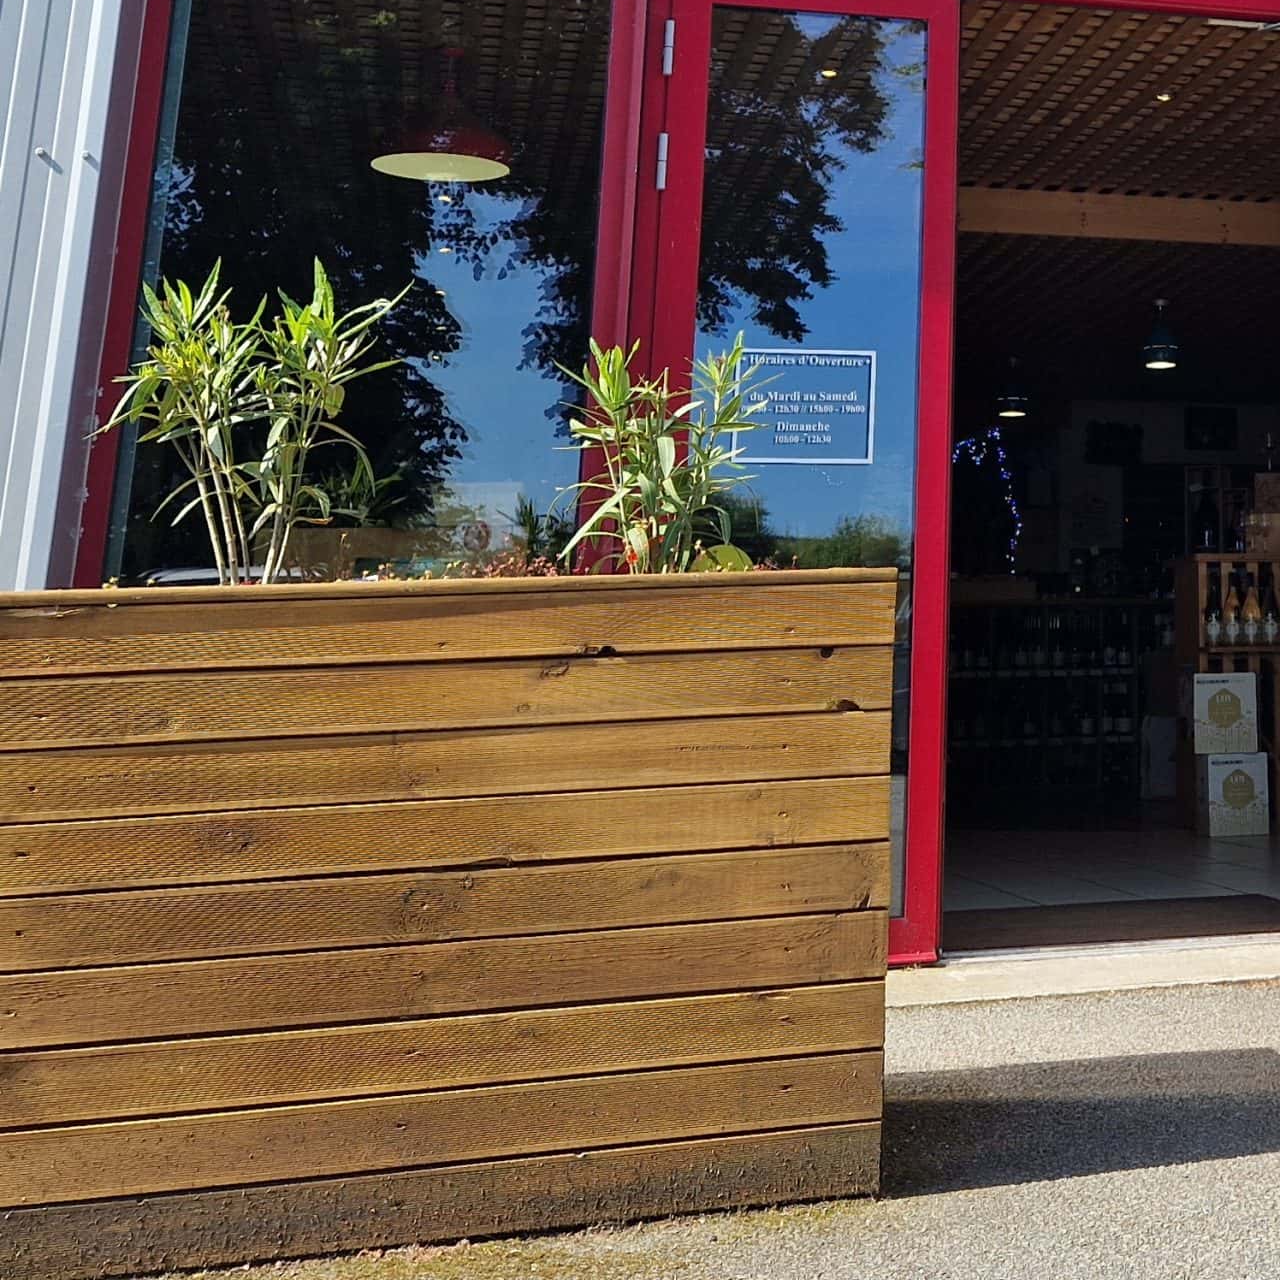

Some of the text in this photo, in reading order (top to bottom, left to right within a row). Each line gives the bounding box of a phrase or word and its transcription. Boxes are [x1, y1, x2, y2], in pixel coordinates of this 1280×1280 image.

[750, 354, 795, 366] Horaires
[750, 390, 857, 402] du Mardi au Samedi
[776, 420, 830, 432] Dimanche
